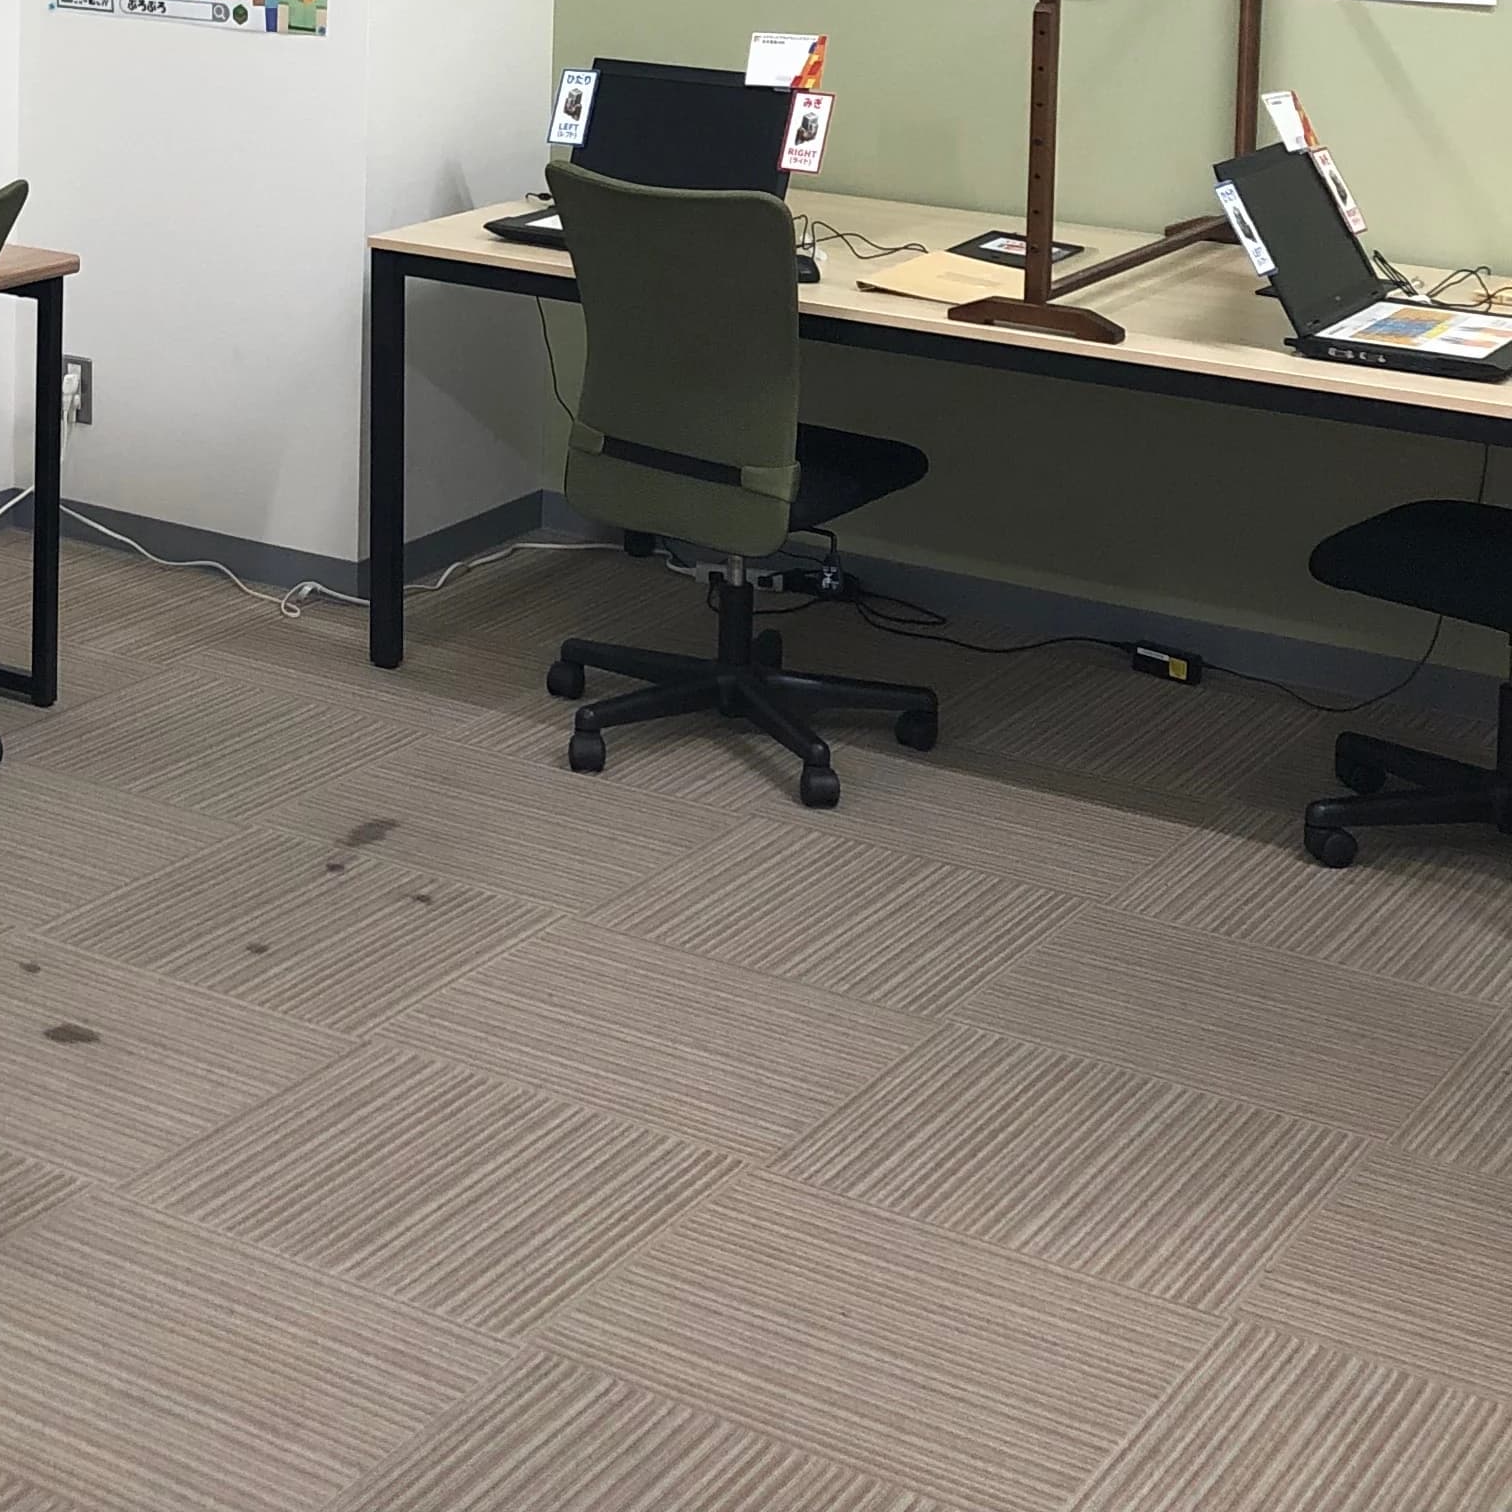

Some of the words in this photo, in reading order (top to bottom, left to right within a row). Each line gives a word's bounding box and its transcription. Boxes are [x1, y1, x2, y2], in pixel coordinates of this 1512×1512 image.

[803, 97, 823, 109] みぎ
[558, 122, 579, 131] LEFT
[788, 147, 818, 158] RIGHT
